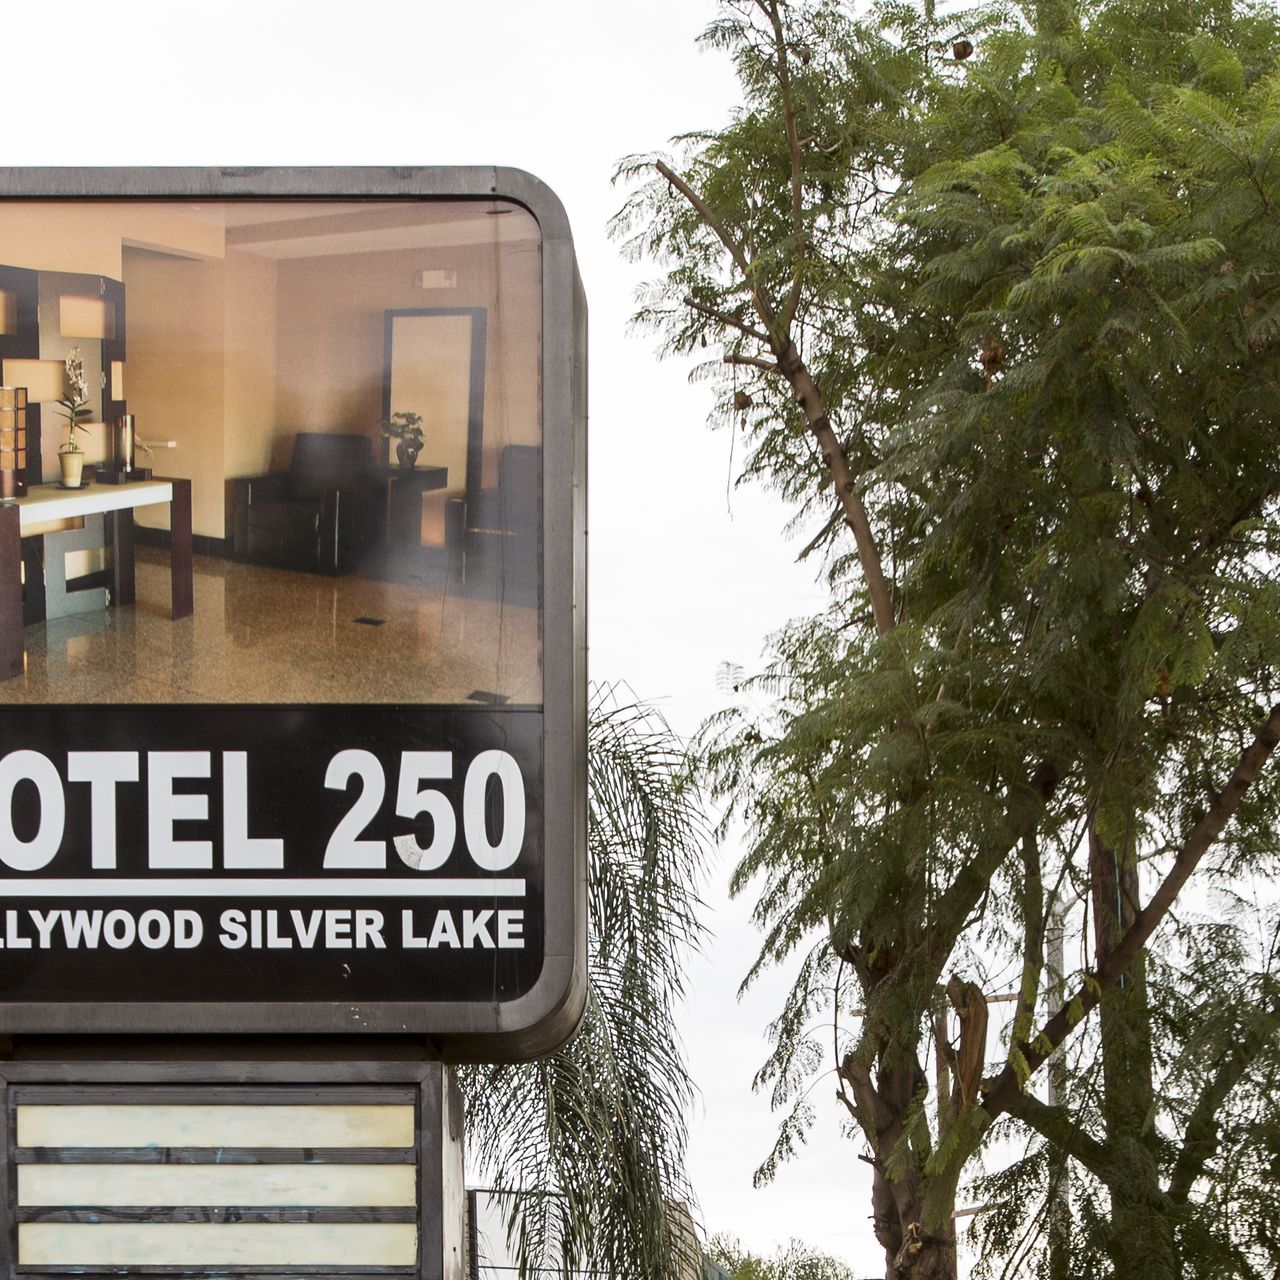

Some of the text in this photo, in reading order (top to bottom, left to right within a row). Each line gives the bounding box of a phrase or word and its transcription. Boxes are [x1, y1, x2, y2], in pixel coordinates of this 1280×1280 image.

[323, 748, 526, 872] 250
[219, 908, 386, 949] SILVER
[402, 909, 525, 949] LAKE
